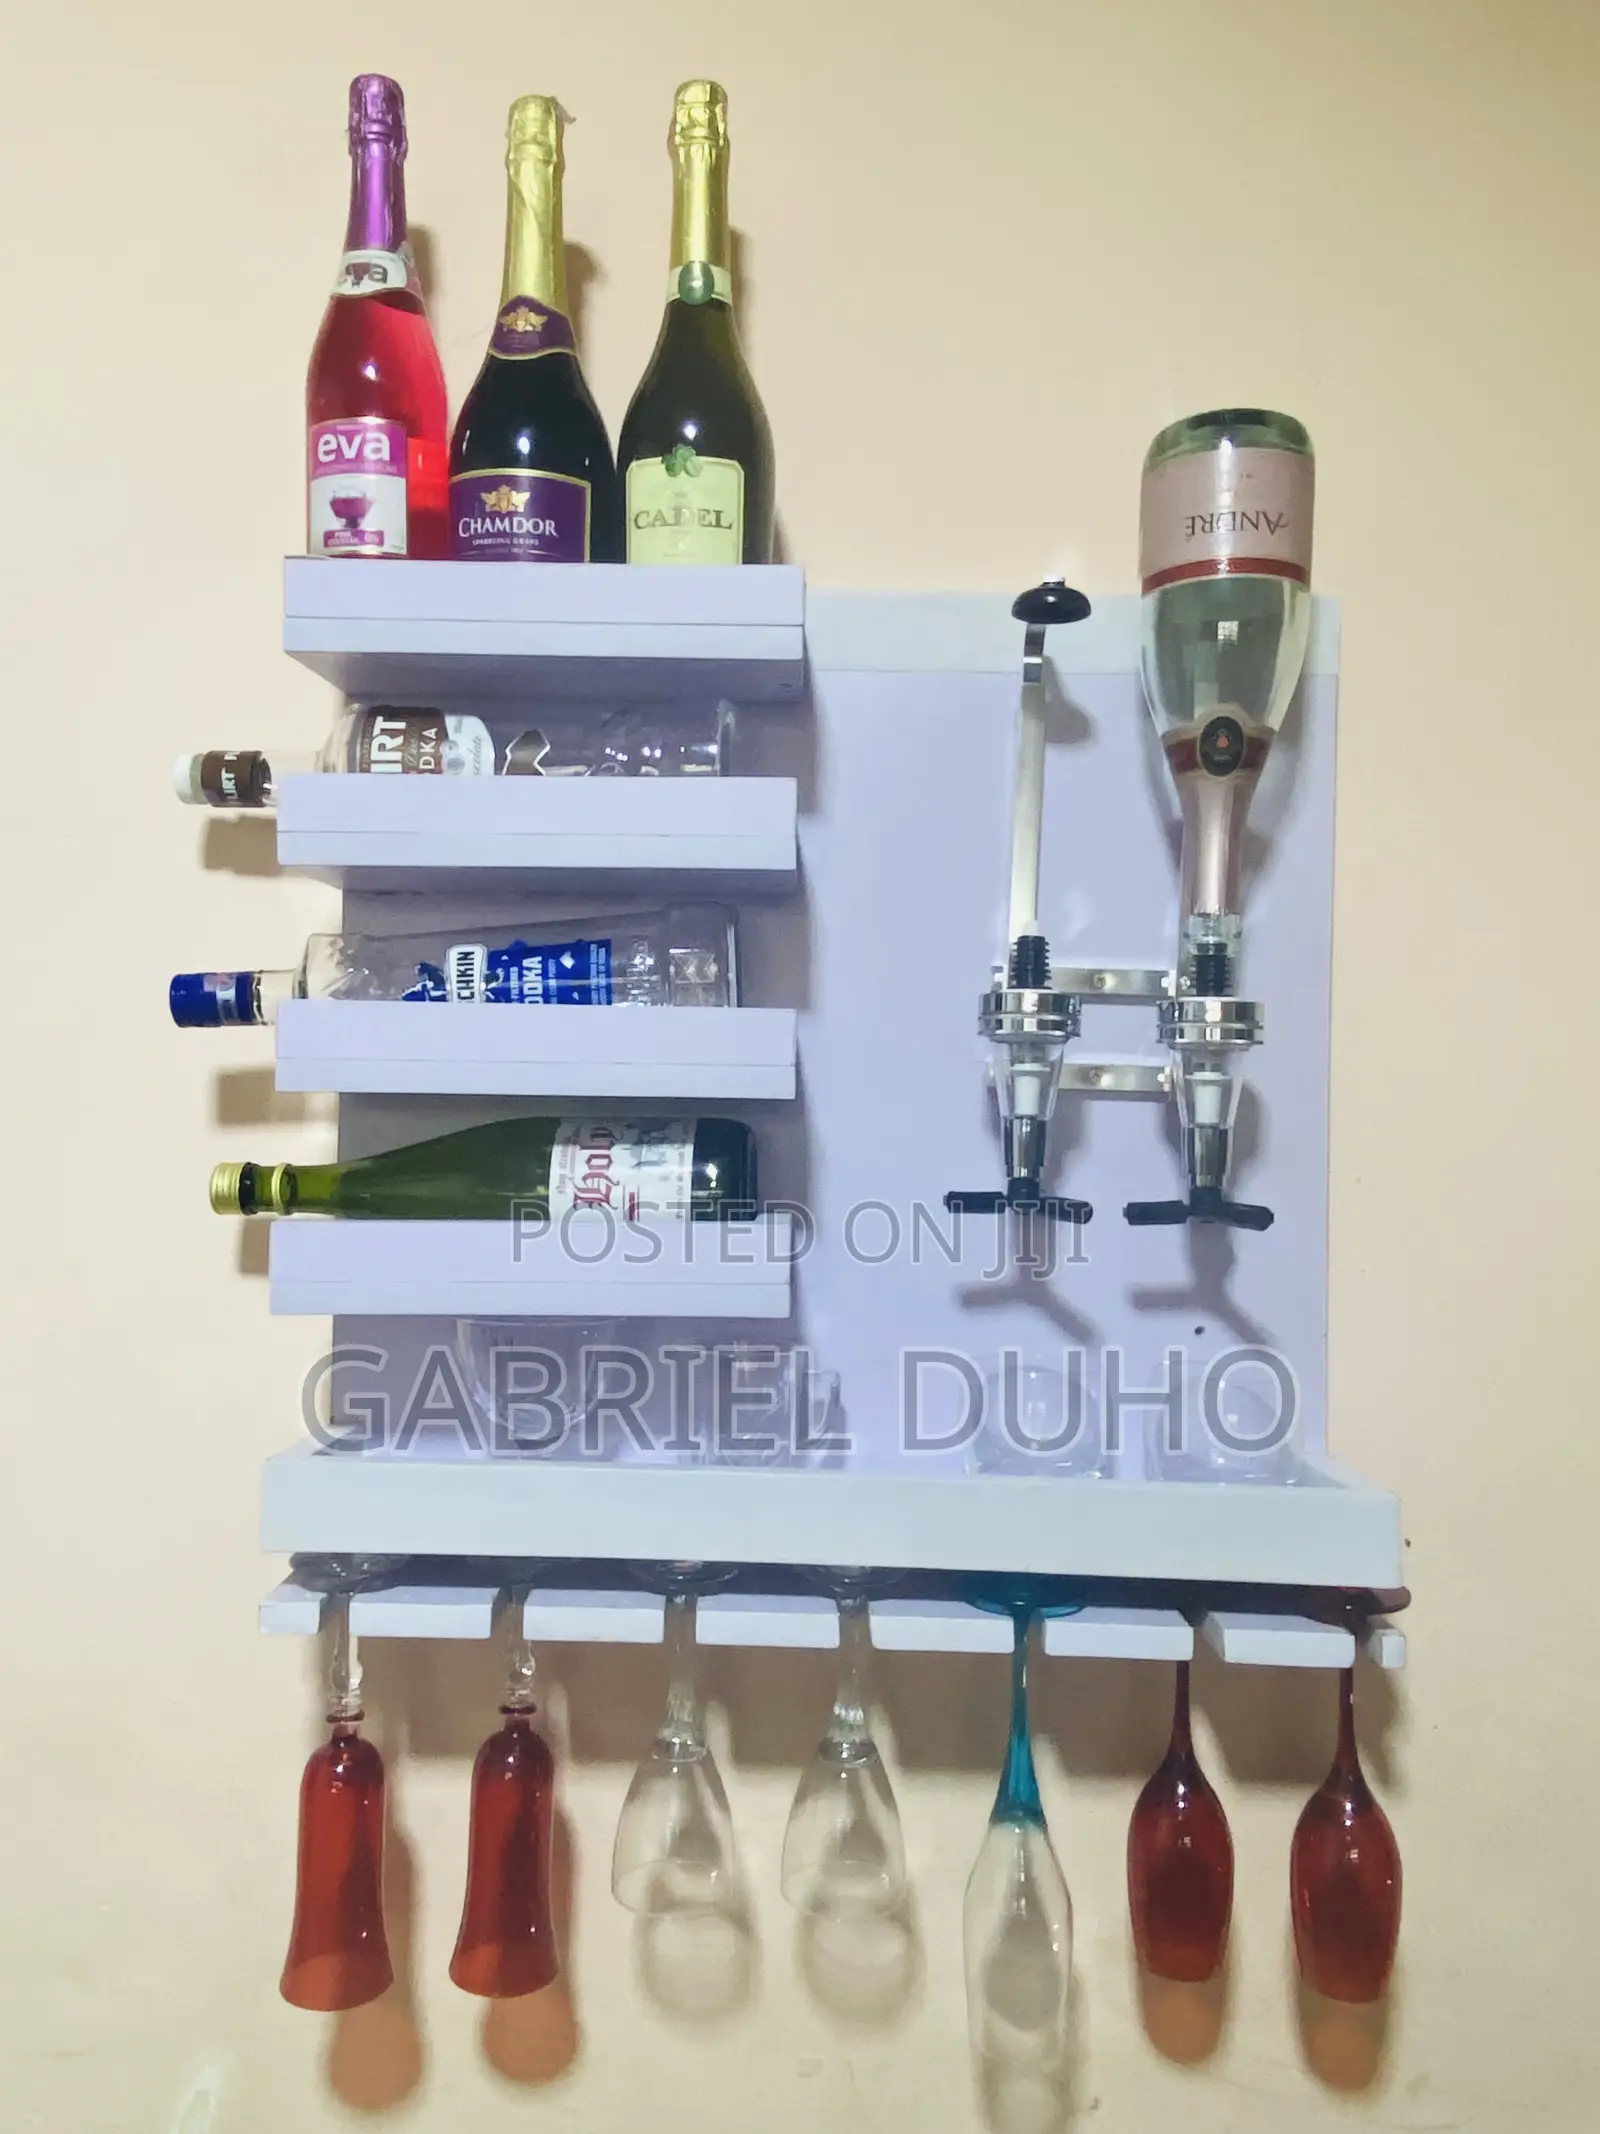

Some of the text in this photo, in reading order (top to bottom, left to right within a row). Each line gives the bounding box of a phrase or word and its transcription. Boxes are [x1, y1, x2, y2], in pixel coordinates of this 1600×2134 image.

[317, 431, 390, 463] eva
[458, 516, 559, 538] CHAMDOR
[370, 715, 407, 773] IRT
[419, 727, 438, 770] DKA
[456, 951, 475, 1001] CHKIN
[522, 956, 544, 1004] ODKA
